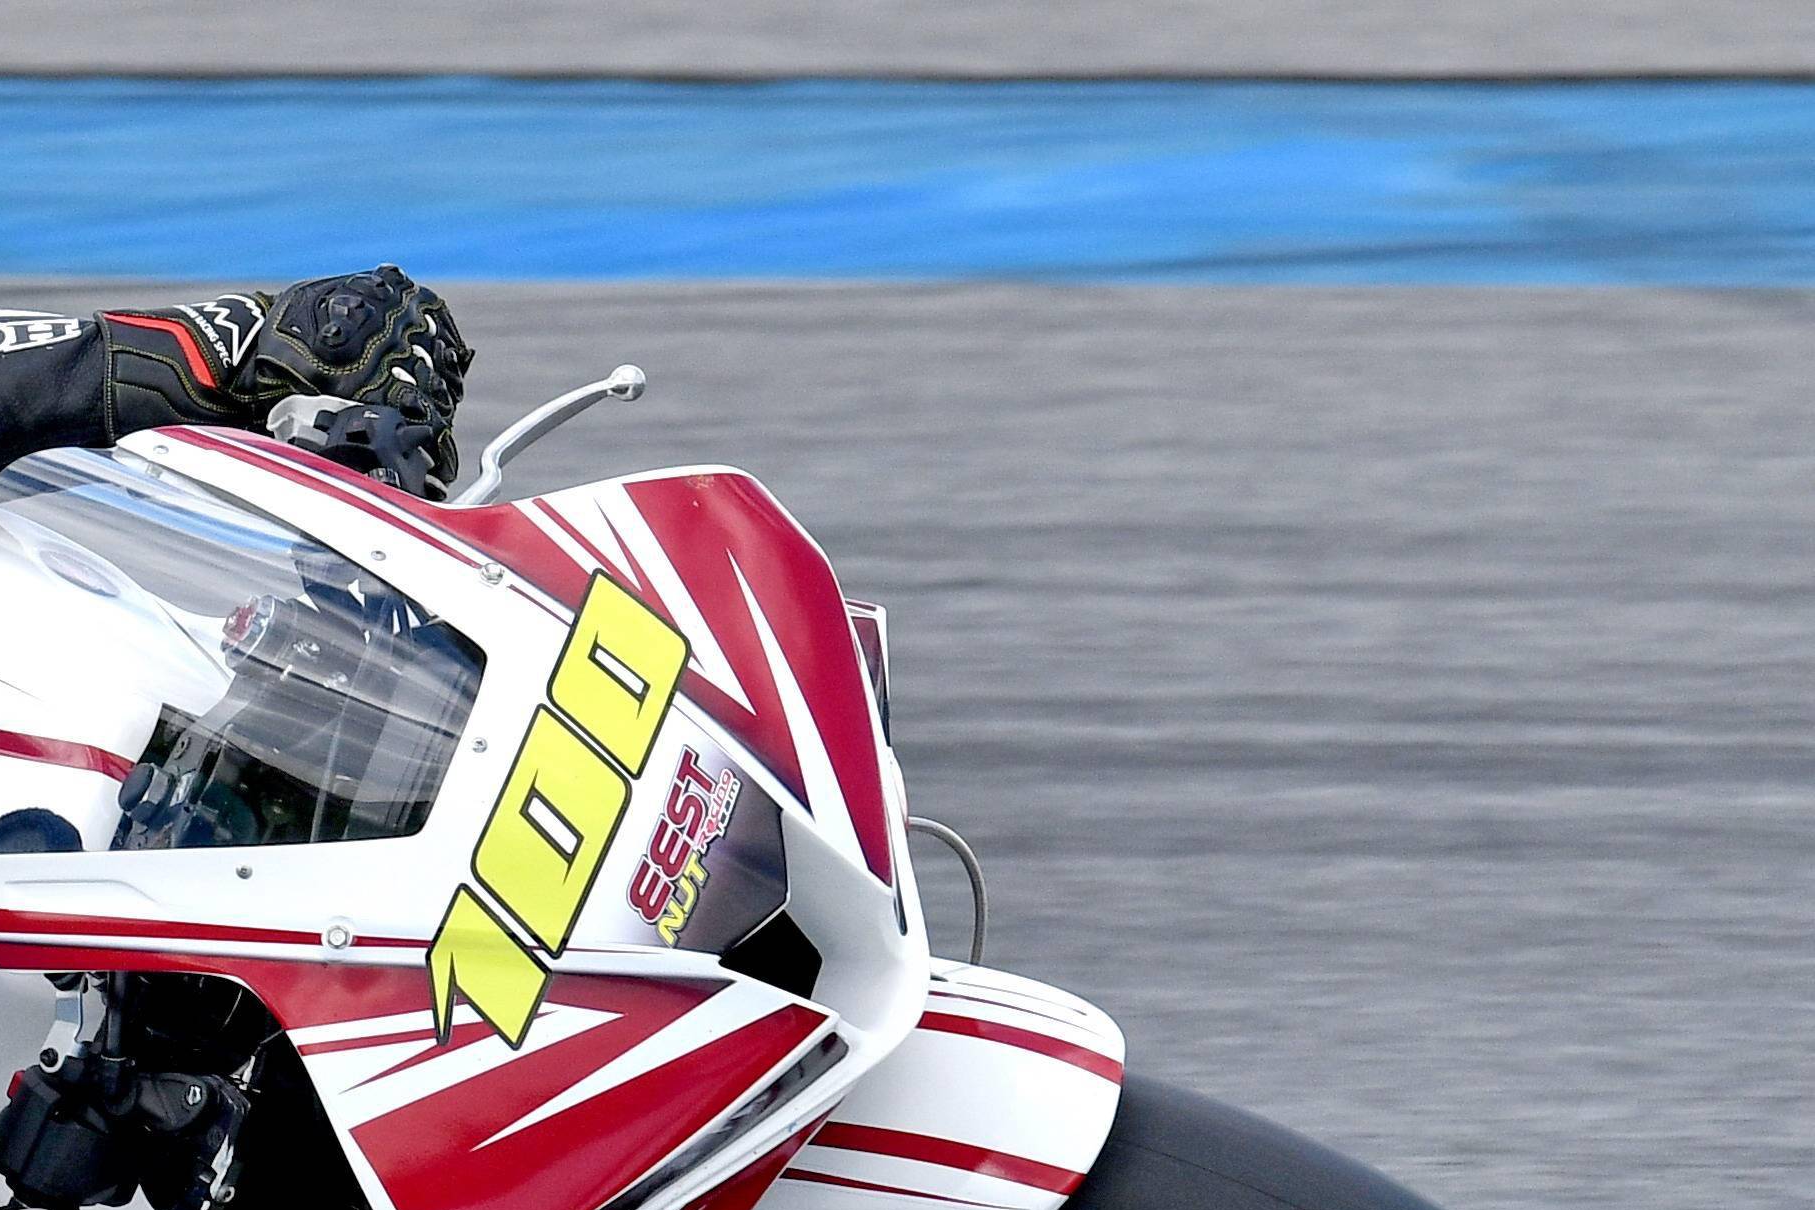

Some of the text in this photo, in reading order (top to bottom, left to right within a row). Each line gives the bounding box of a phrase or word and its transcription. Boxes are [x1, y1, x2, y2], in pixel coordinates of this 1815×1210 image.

[426, 568, 691, 1051] 100
[627, 744, 717, 925] EEST
[657, 851, 708, 947] NUT
